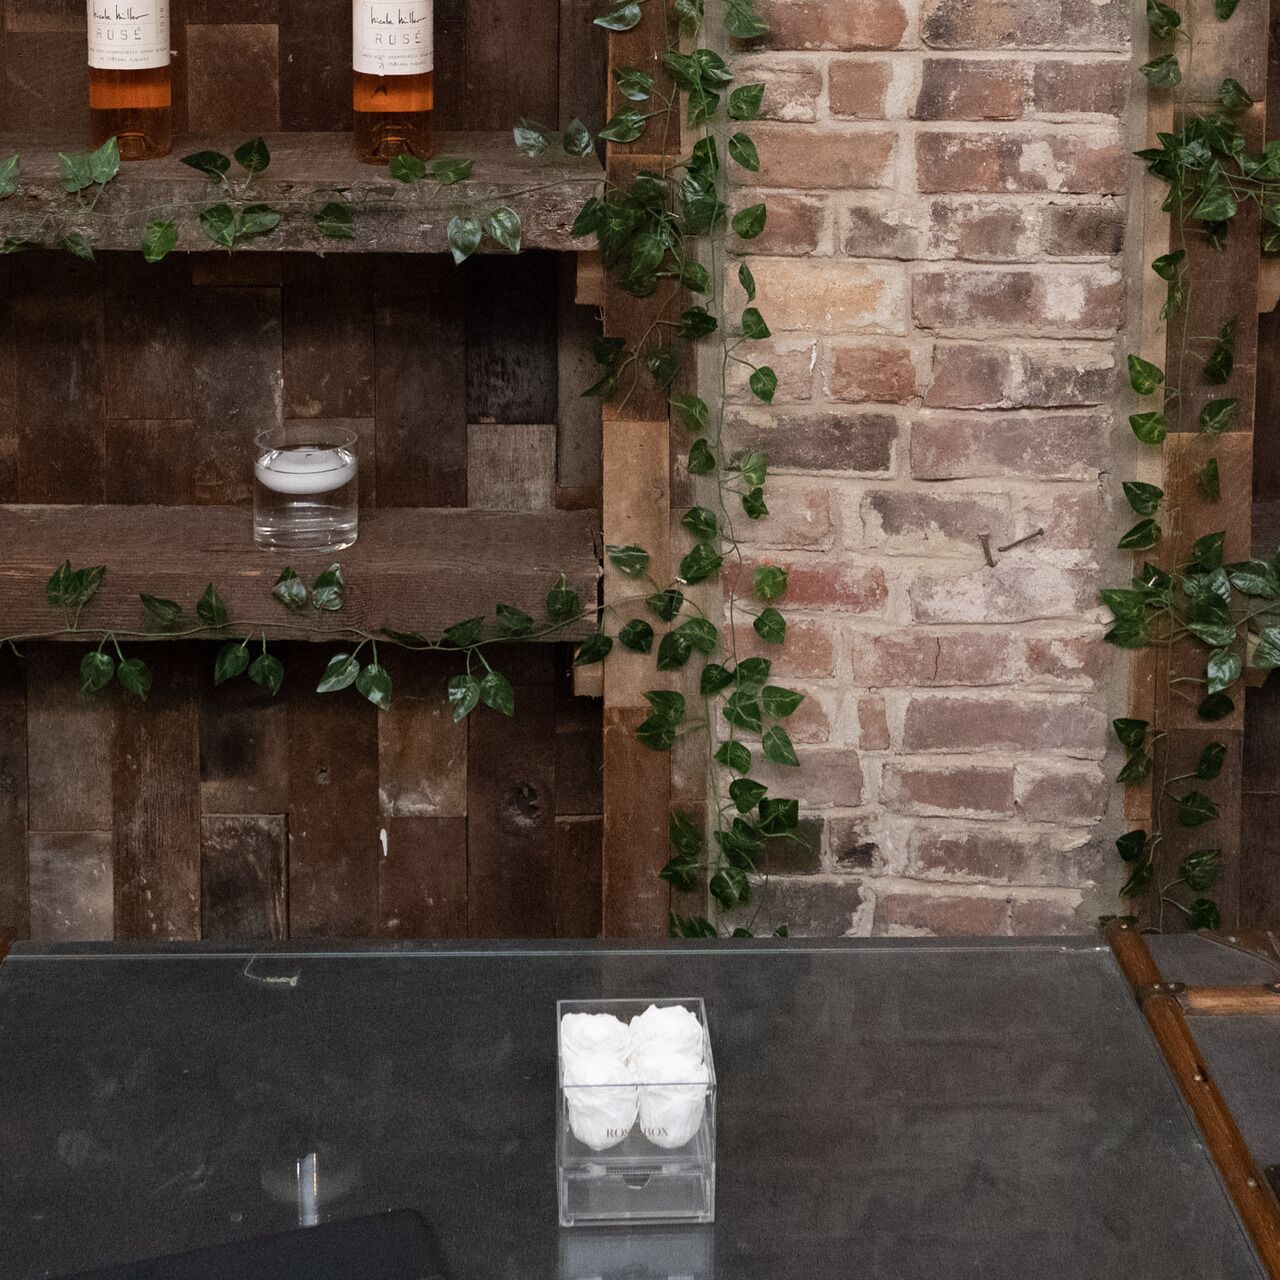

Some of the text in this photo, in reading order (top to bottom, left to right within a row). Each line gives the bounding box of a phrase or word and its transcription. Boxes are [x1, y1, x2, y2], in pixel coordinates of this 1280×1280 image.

[95, 26, 142, 41] ROSÉ
[375, 29, 422, 46] ROSÉ
[606, 1127, 633, 1138] ROS
